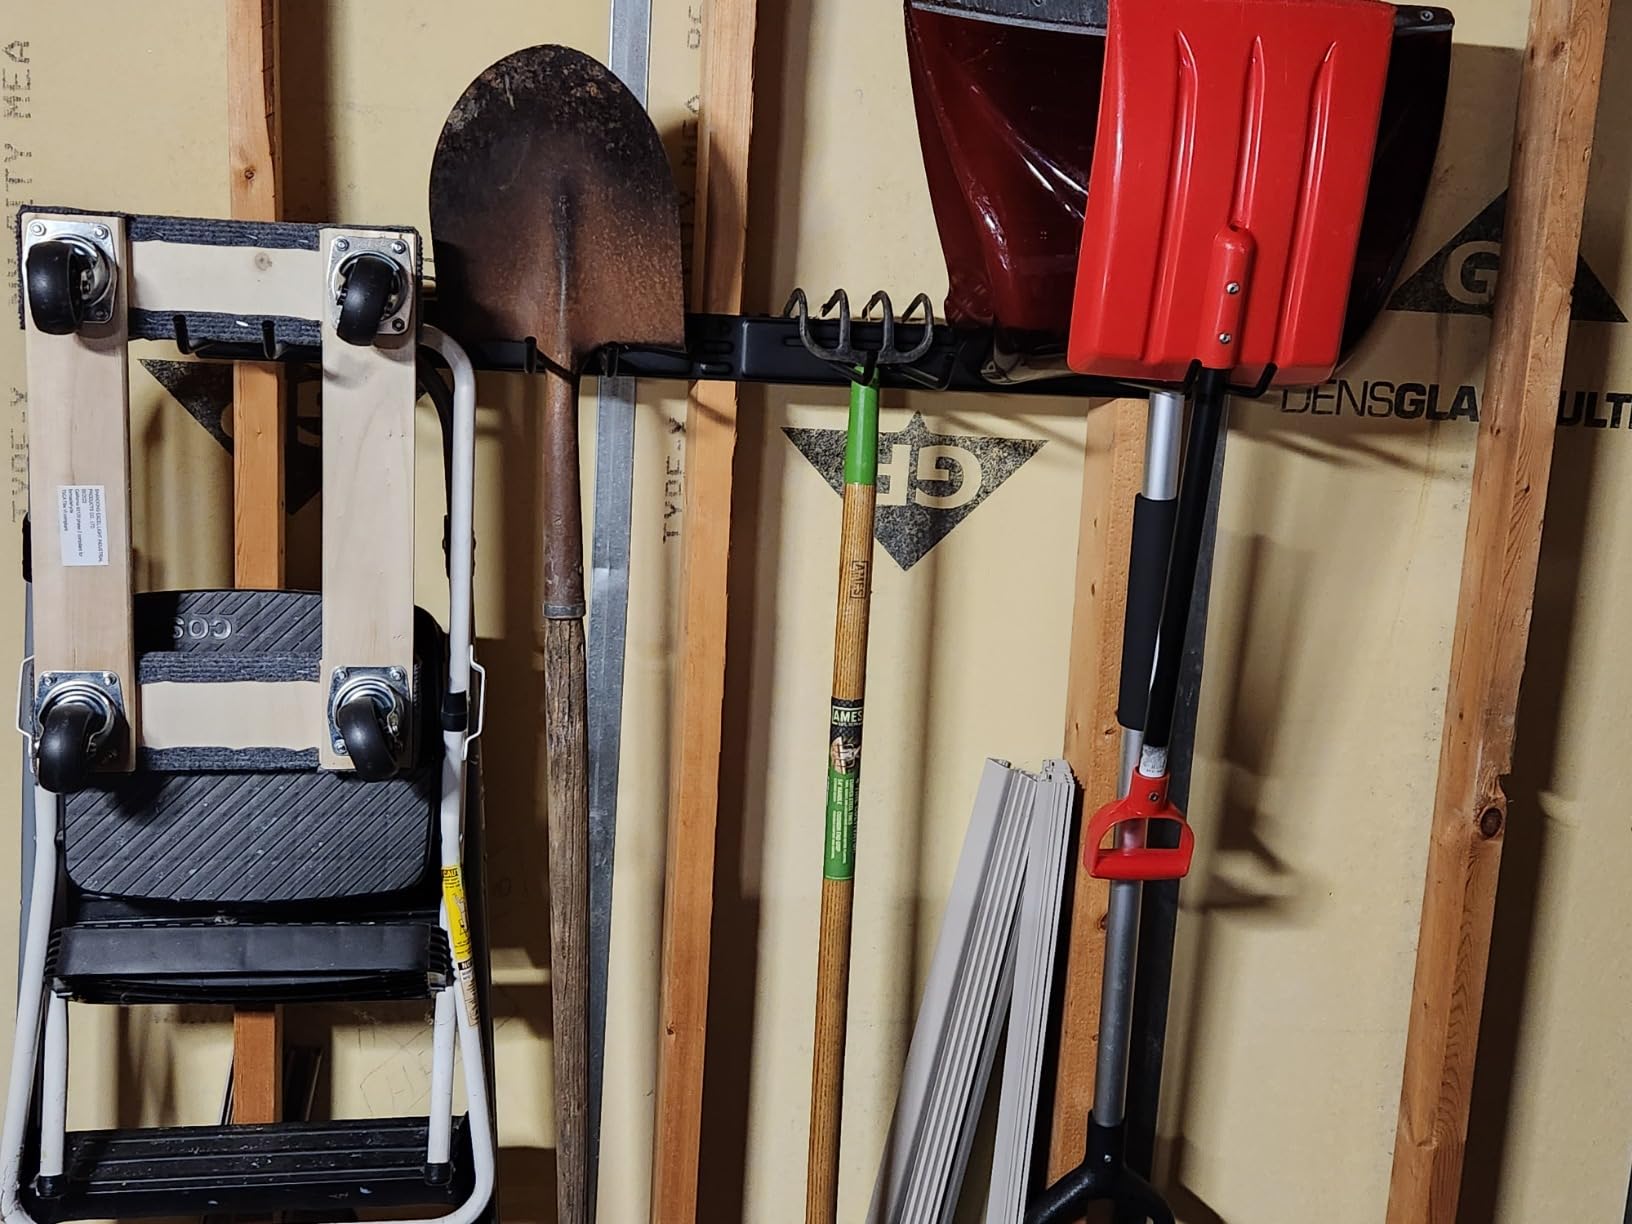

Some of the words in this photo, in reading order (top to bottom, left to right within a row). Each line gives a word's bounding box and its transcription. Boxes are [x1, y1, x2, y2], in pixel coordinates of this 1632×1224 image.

[3, 40, 32, 118] MEA
[1443, 240, 1503, 304] G
[1280, 379, 1481, 422] DENSGLA
[1557, 390, 1632, 429] ULT
[853, 564, 865, 596] AMES
[833, 710, 863, 723] AMES
